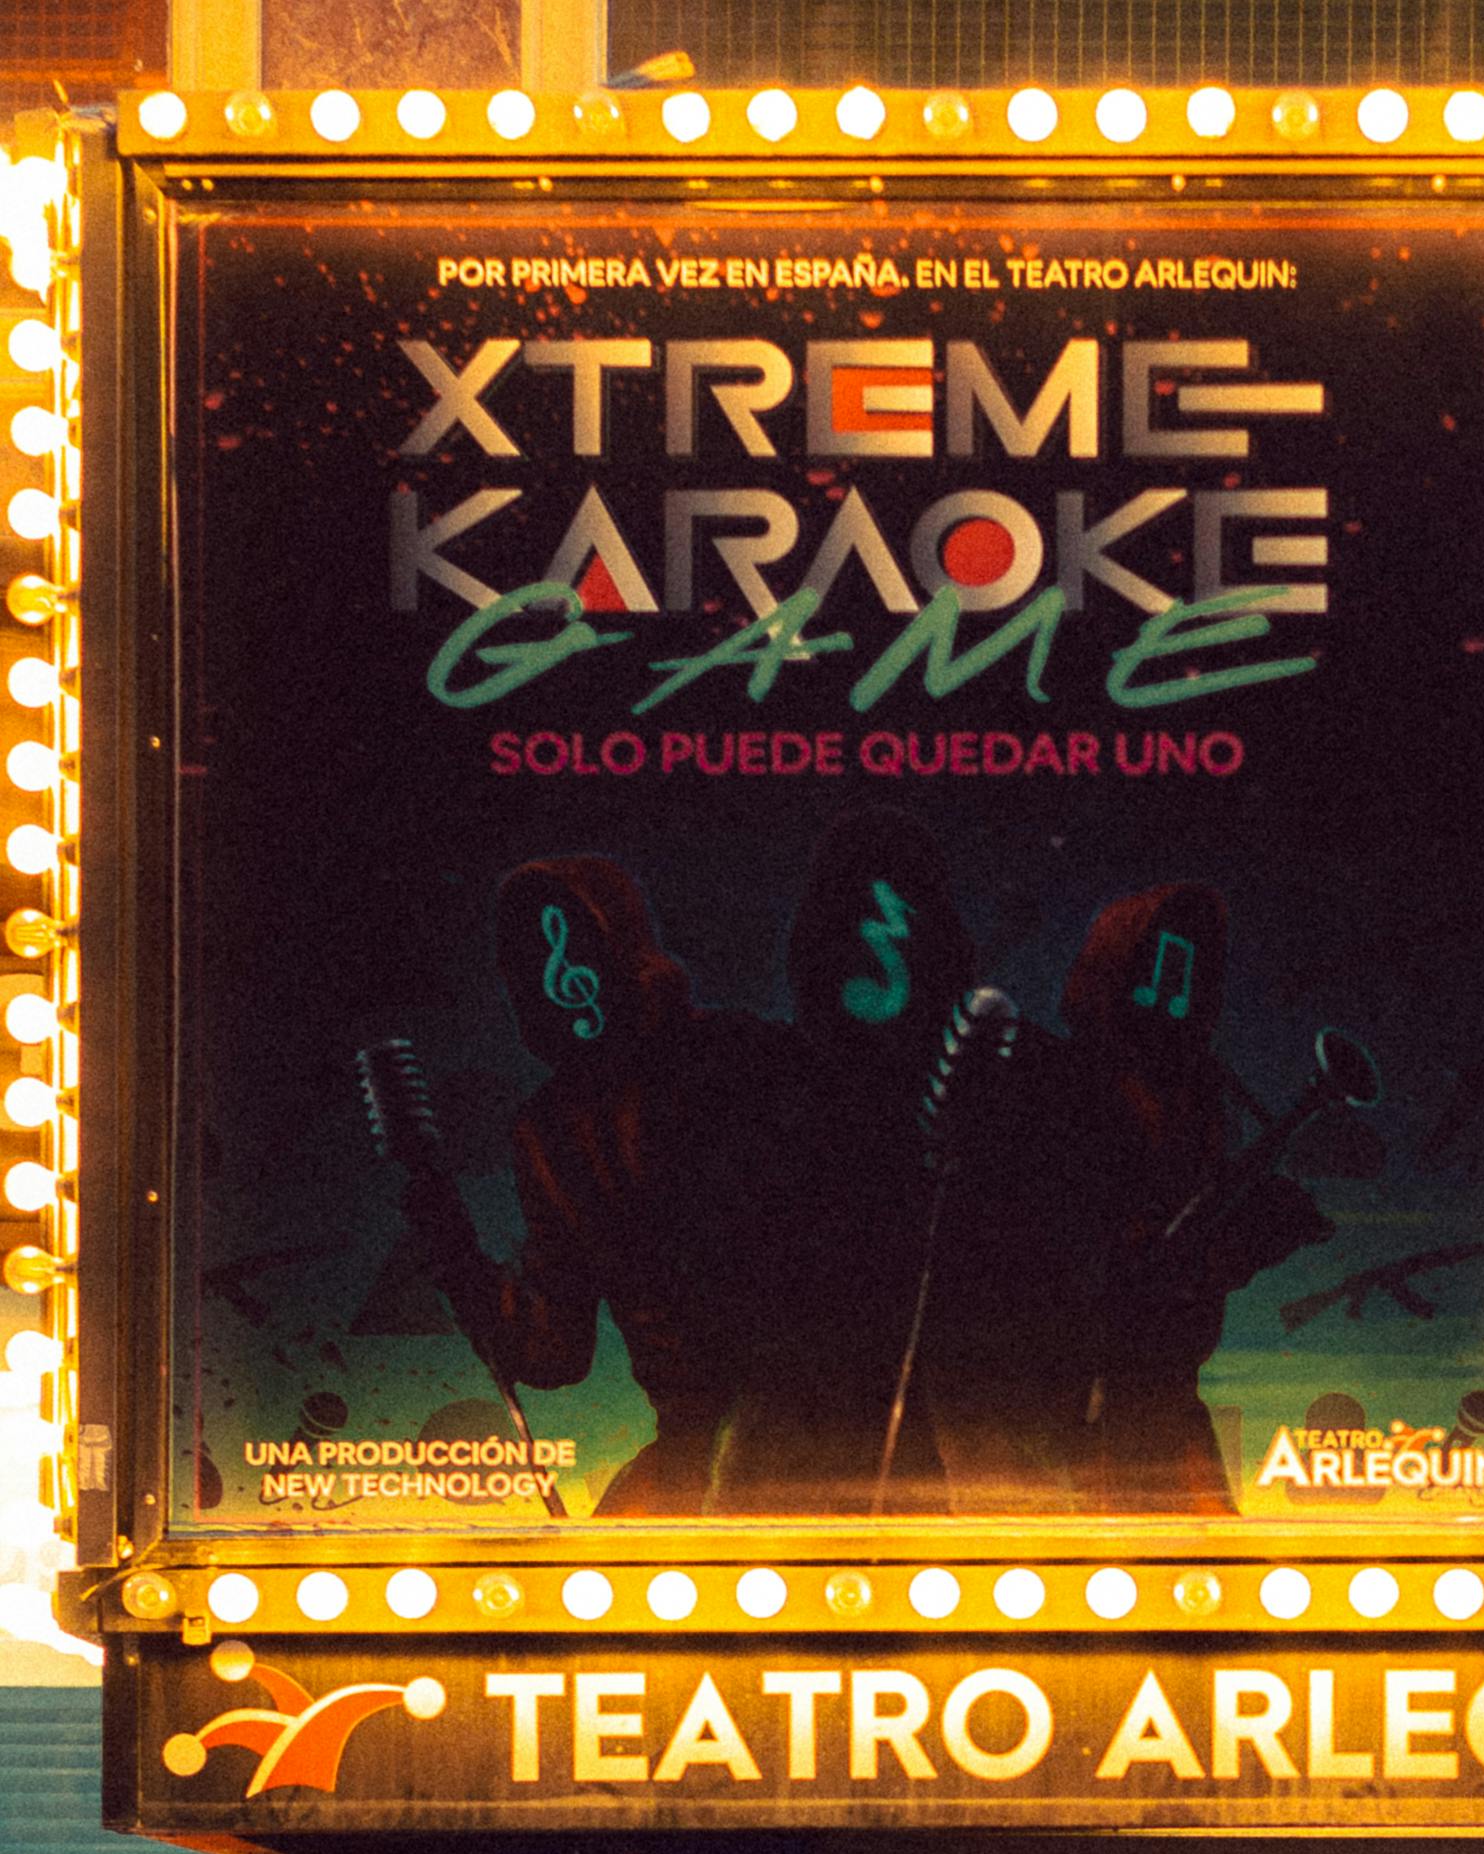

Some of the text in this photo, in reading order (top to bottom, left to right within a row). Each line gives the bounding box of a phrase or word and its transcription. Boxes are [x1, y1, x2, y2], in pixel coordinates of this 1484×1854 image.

[438, 258, 505, 287] POR
[512, 258, 650, 288] PRIMERA
[656, 259, 721, 287] VEZ
[726, 259, 768, 287] EN
[775, 253, 910, 288] ESPAÑA.
[915, 259, 963, 288] EN
[970, 259, 999, 288] EL
[1006, 258, 1129, 289] TEATRO
[399, 338, 1324, 458] XTREME
[390, 486, 1328, 614] KARAOKE
[426, 581, 1318, 713] GAME
[489, 729, 1244, 778] SOLO PUEDE QUEDAR UNO
[245, 1435, 576, 1468] UNA PRODUCCIÓN DE
[1295, 1430, 1384, 1450] TEATRO
[262, 1472, 558, 1500] NEW TECHNOLOGY
[485, 1667, 1055, 1782] TEATRO
